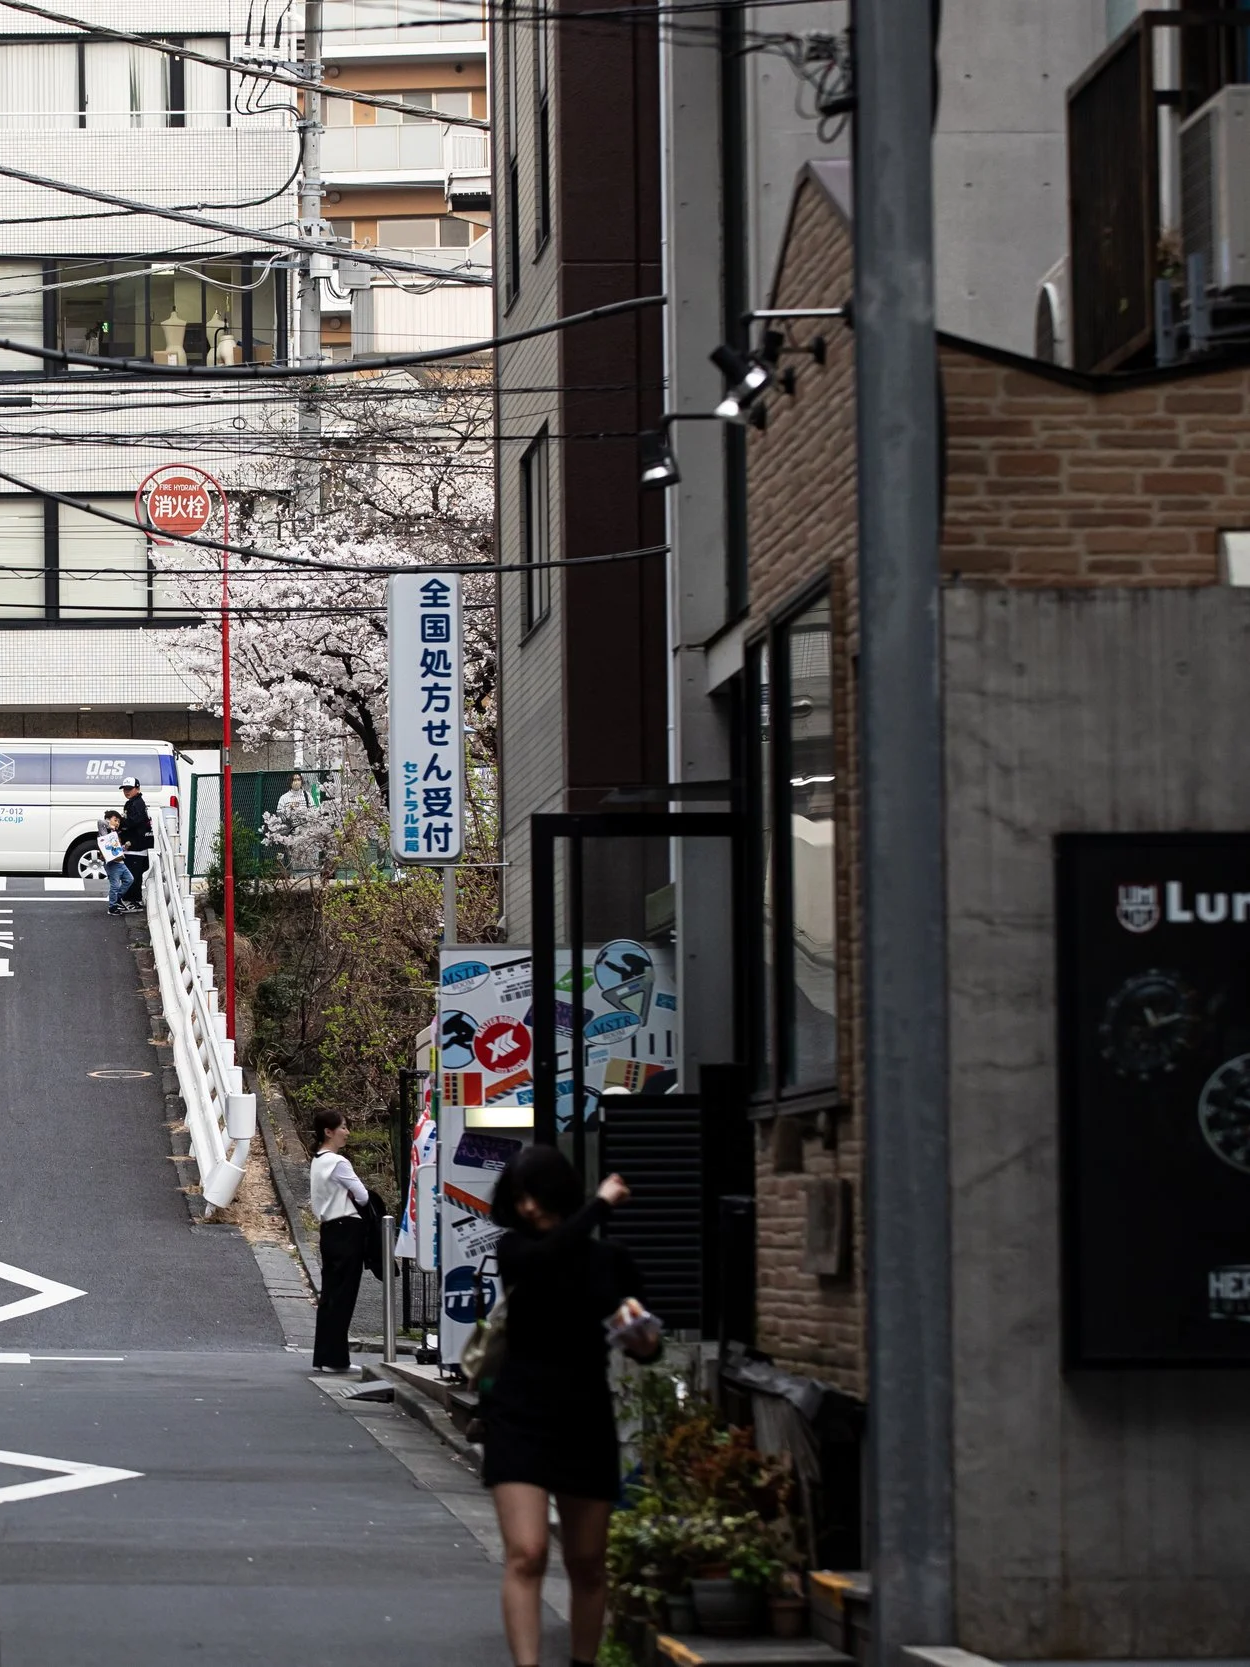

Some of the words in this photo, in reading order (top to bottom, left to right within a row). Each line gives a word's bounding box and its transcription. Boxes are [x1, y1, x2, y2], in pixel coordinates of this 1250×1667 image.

[173, 484, 200, 492] HYDRANT
[154, 494, 206, 519] 消火栓
[419, 578, 453, 853] 全国処方せん受付
[86, 759, 126, 776] OCS
[403, 761, 420, 853] セントラル薬局
[592, 1015, 632, 1035] MSTR
